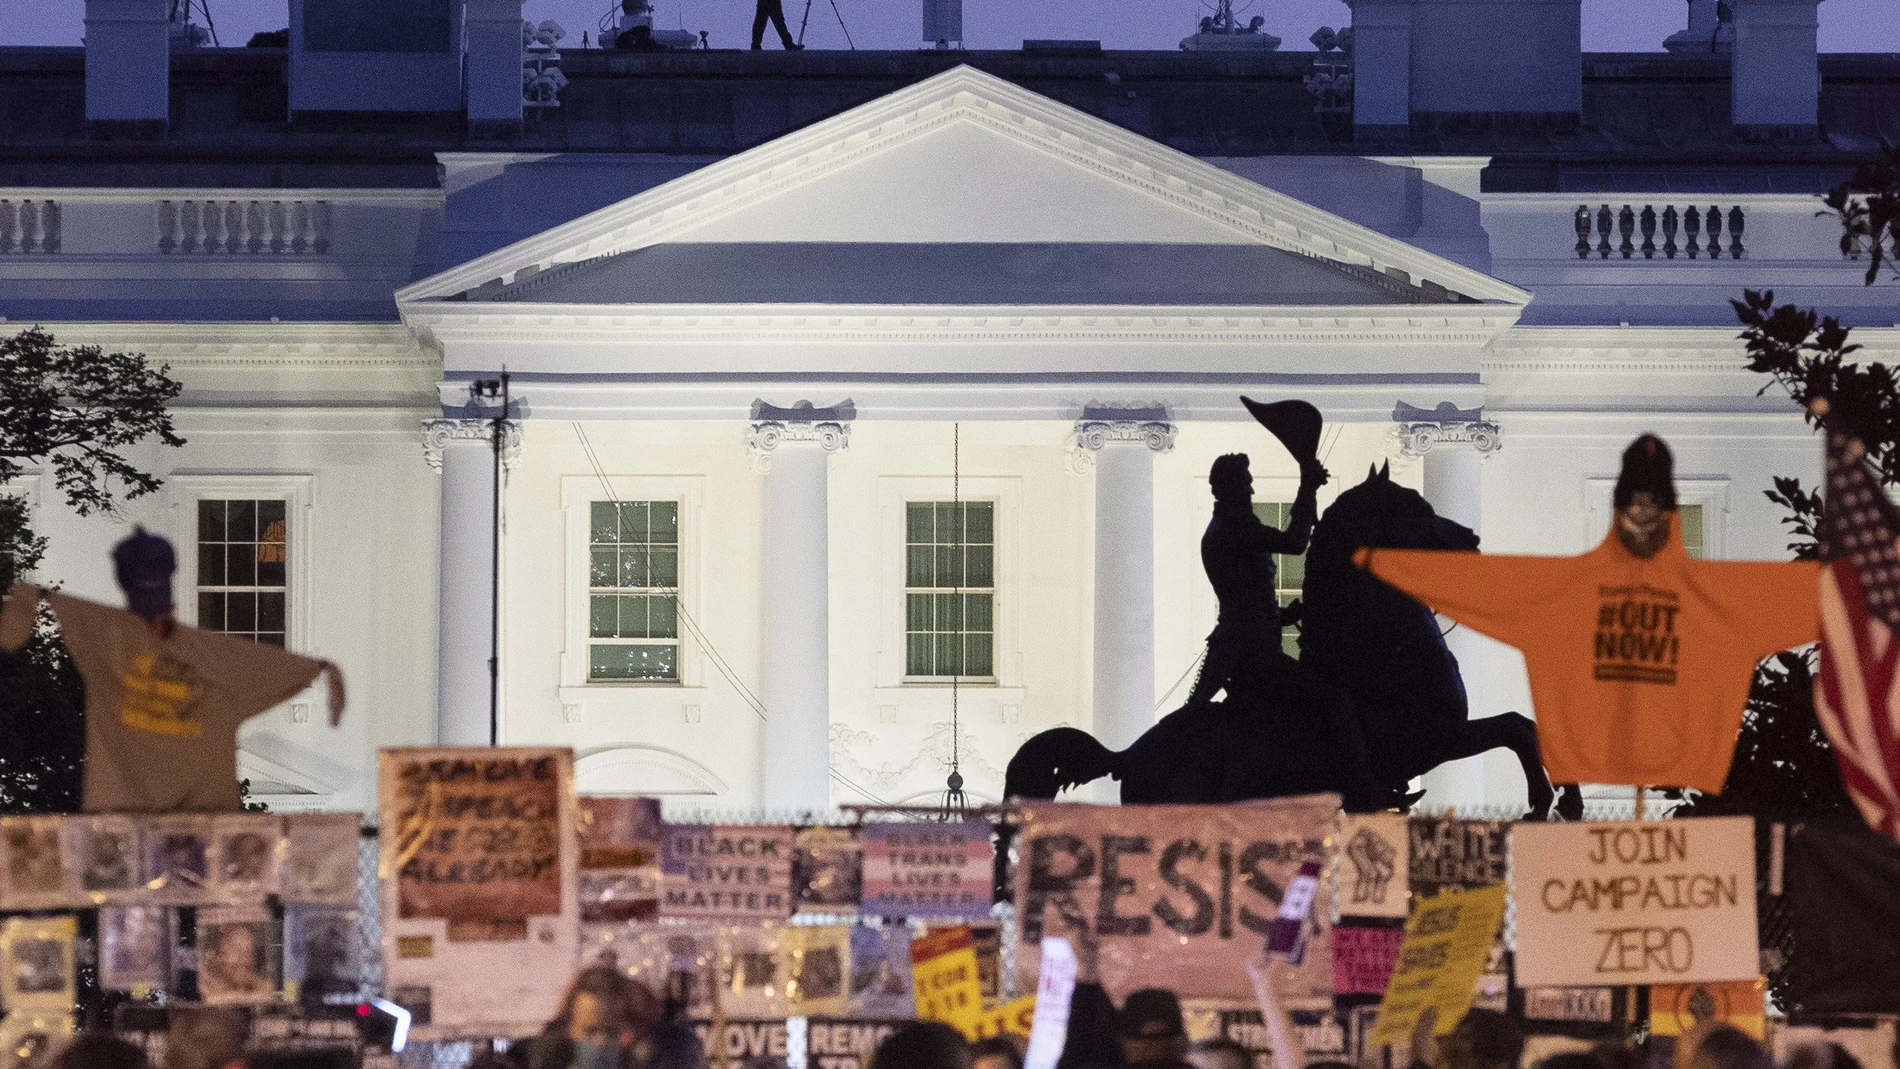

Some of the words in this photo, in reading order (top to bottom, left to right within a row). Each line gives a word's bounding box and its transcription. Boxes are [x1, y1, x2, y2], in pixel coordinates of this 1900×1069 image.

[1599, 601, 1679, 632] #OUT
[1595, 631, 1679, 665] NOW!
[675, 837, 779, 856] BLACK
[1588, 825, 1686, 864] JOIN
[690, 867, 771, 882] LIVES
[666, 891, 782, 909] MATTER
[1542, 874, 1736, 914] CAMPAIGN
[1594, 925, 1692, 973] ZERO
